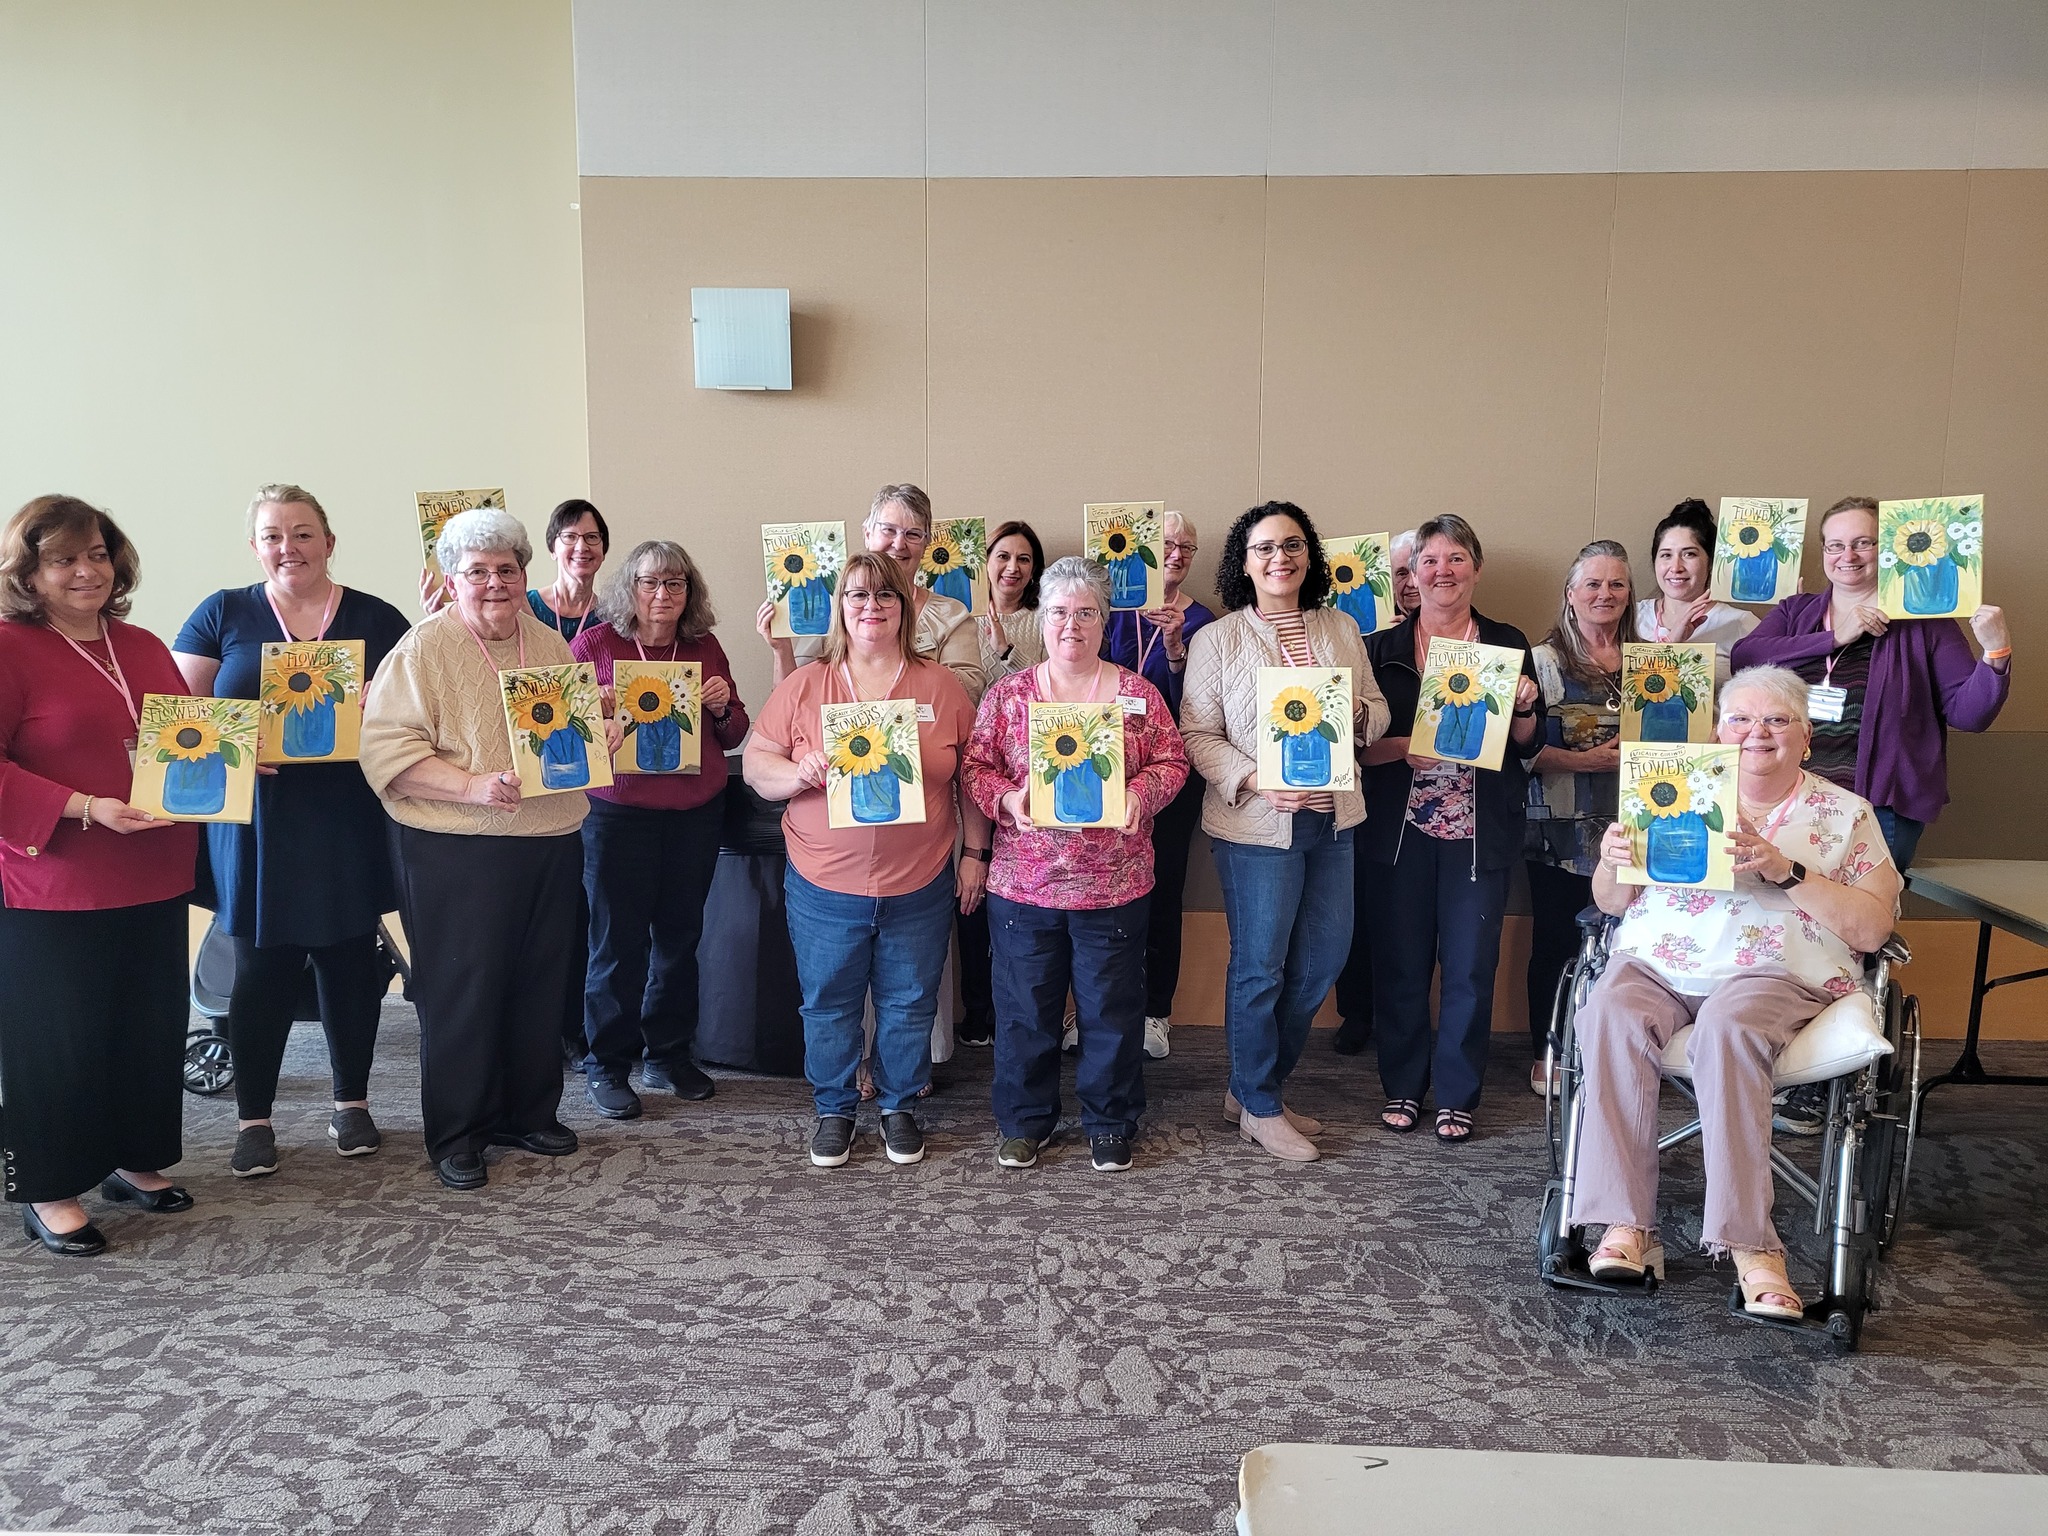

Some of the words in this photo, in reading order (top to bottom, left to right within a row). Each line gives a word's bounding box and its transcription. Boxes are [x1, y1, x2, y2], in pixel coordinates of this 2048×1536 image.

[419, 497, 473, 518] FLOWERS
[1087, 512, 1135, 534] FLOWERS
[764, 530, 812, 552] FLOWERS
[283, 651, 342, 667] FLOWERS
[1428, 650, 1480, 667] FLOWERS
[1624, 654, 1680, 670] FLOWERS
[504, 674, 562, 703] FLOWERS
[143, 702, 216, 723] FLOWERS
[824, 705, 881, 739] FLOWERS
[1031, 710, 1088, 735] FLOWERS
[1624, 755, 1695, 779] FLOWERS
